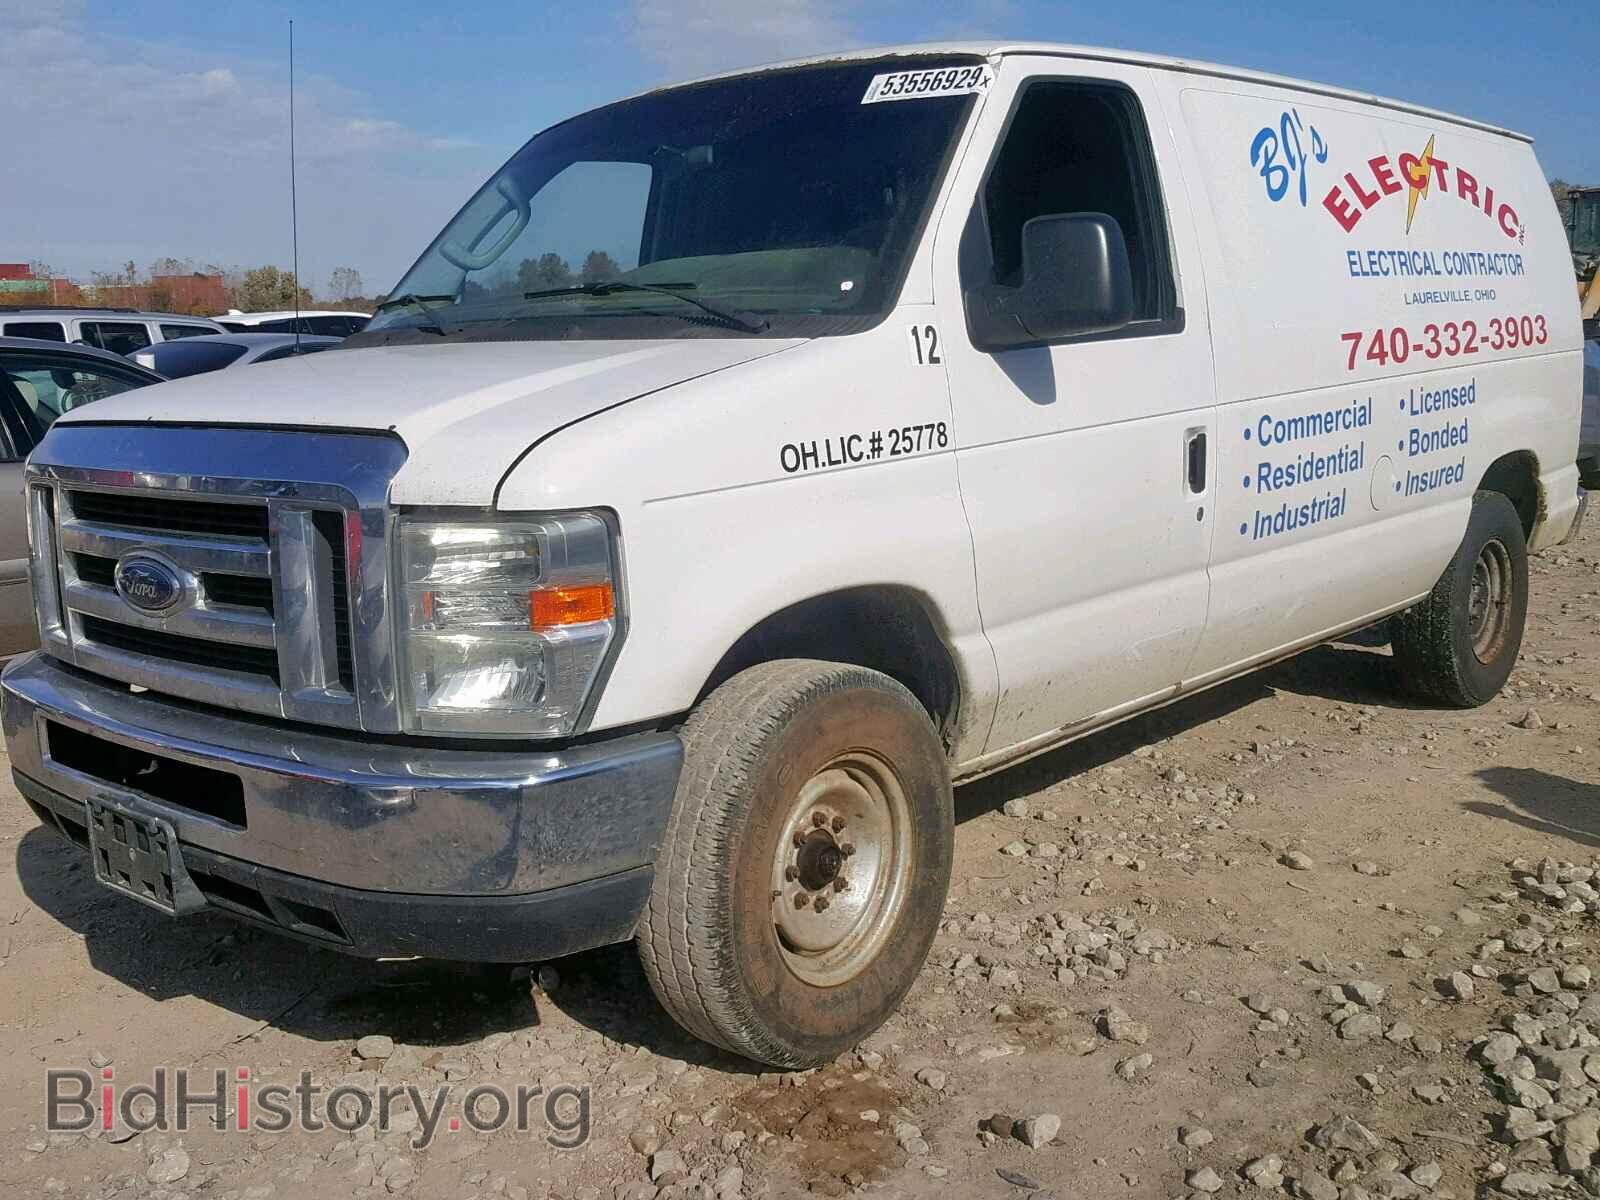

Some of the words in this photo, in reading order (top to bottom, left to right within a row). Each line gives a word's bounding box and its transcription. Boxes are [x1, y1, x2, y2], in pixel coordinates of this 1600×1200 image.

[880, 66, 983, 96] 53556929
[1322, 152, 1519, 239] ELECTRIC
[1346, 250, 1442, 277] ELECTRICAL
[1443, 252, 1525, 276] CONTRACTOR
[1474, 285, 1496, 301] OHIO
[911, 325, 941, 364] 12
[1341, 314, 1548, 370] 740-332-3903
[1410, 377, 1476, 416] Licensed
[888, 421, 948, 456] 25778
[1257, 397, 1372, 447] Commercial
[1408, 418, 1469, 457] Bonded
[1257, 441, 1365, 494] Residential
[1405, 456, 1465, 497] Insured
[1253, 487, 1346, 540] Industrial
